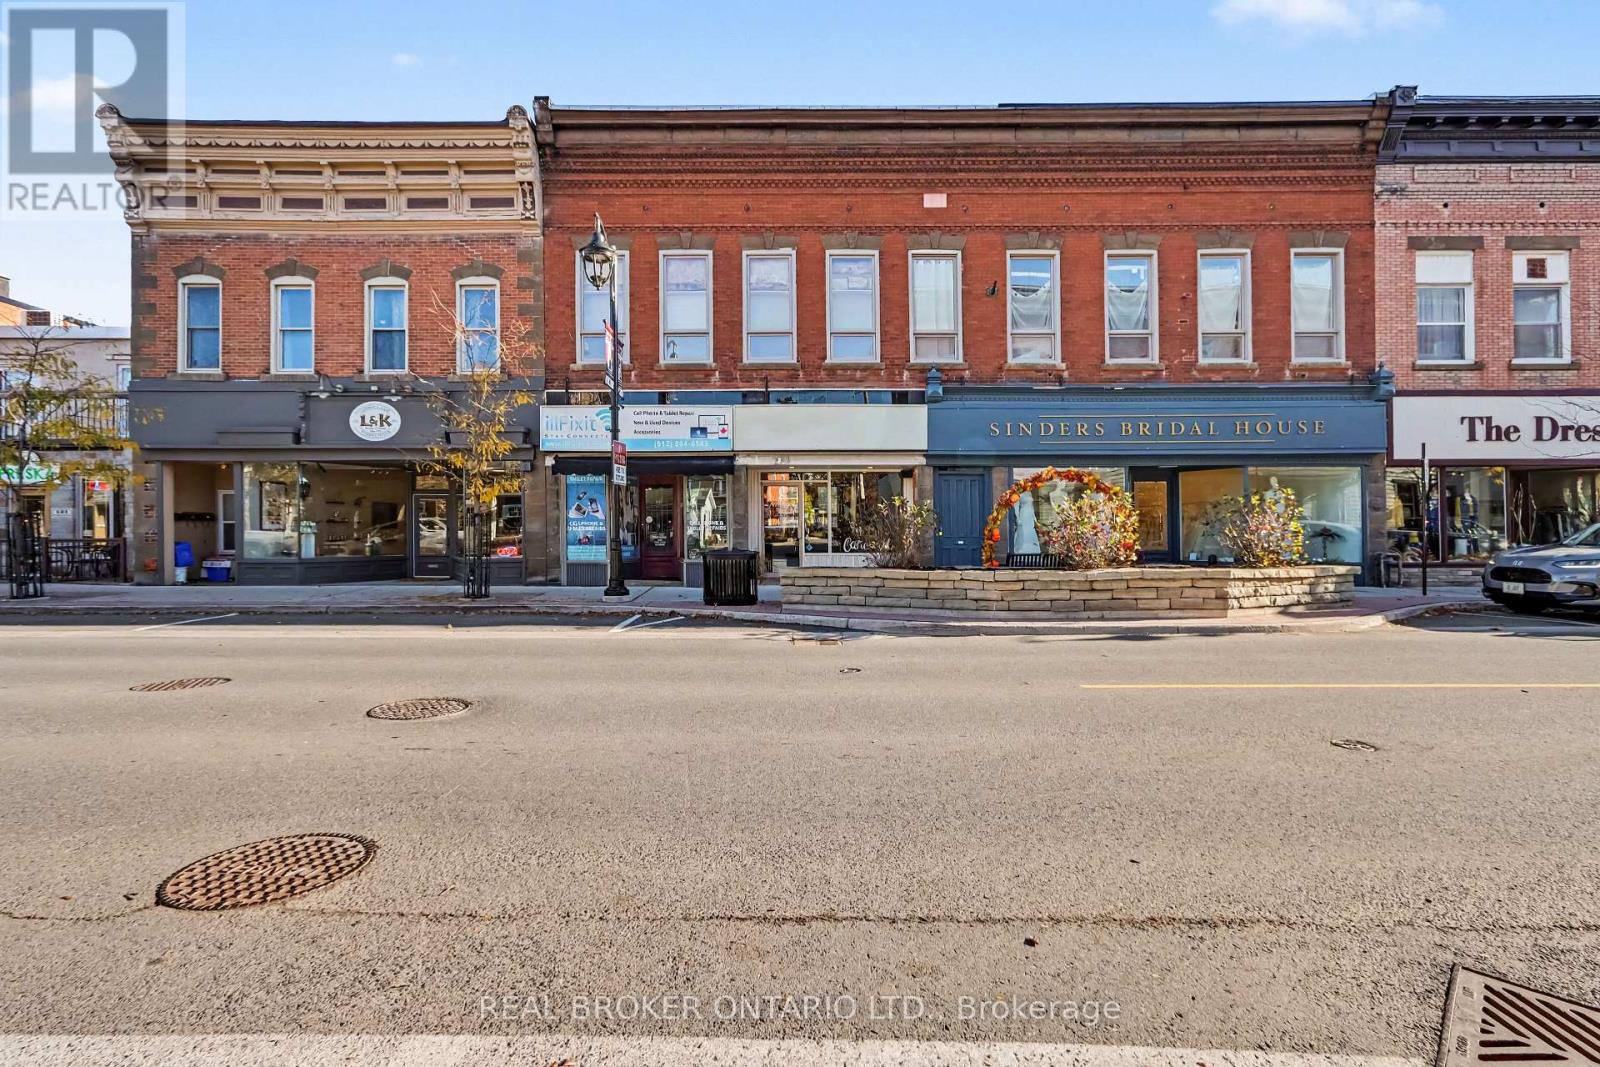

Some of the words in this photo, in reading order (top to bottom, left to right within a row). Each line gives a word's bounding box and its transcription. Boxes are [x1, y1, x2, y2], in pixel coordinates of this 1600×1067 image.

[360, 413, 392, 427] L&K
[990, 422, 1105, 436] SINDERS
[1120, 421, 1219, 436] BRIDAL
[1234, 420, 1325, 435] HOUSE
[1460, 416, 1521, 442] The
